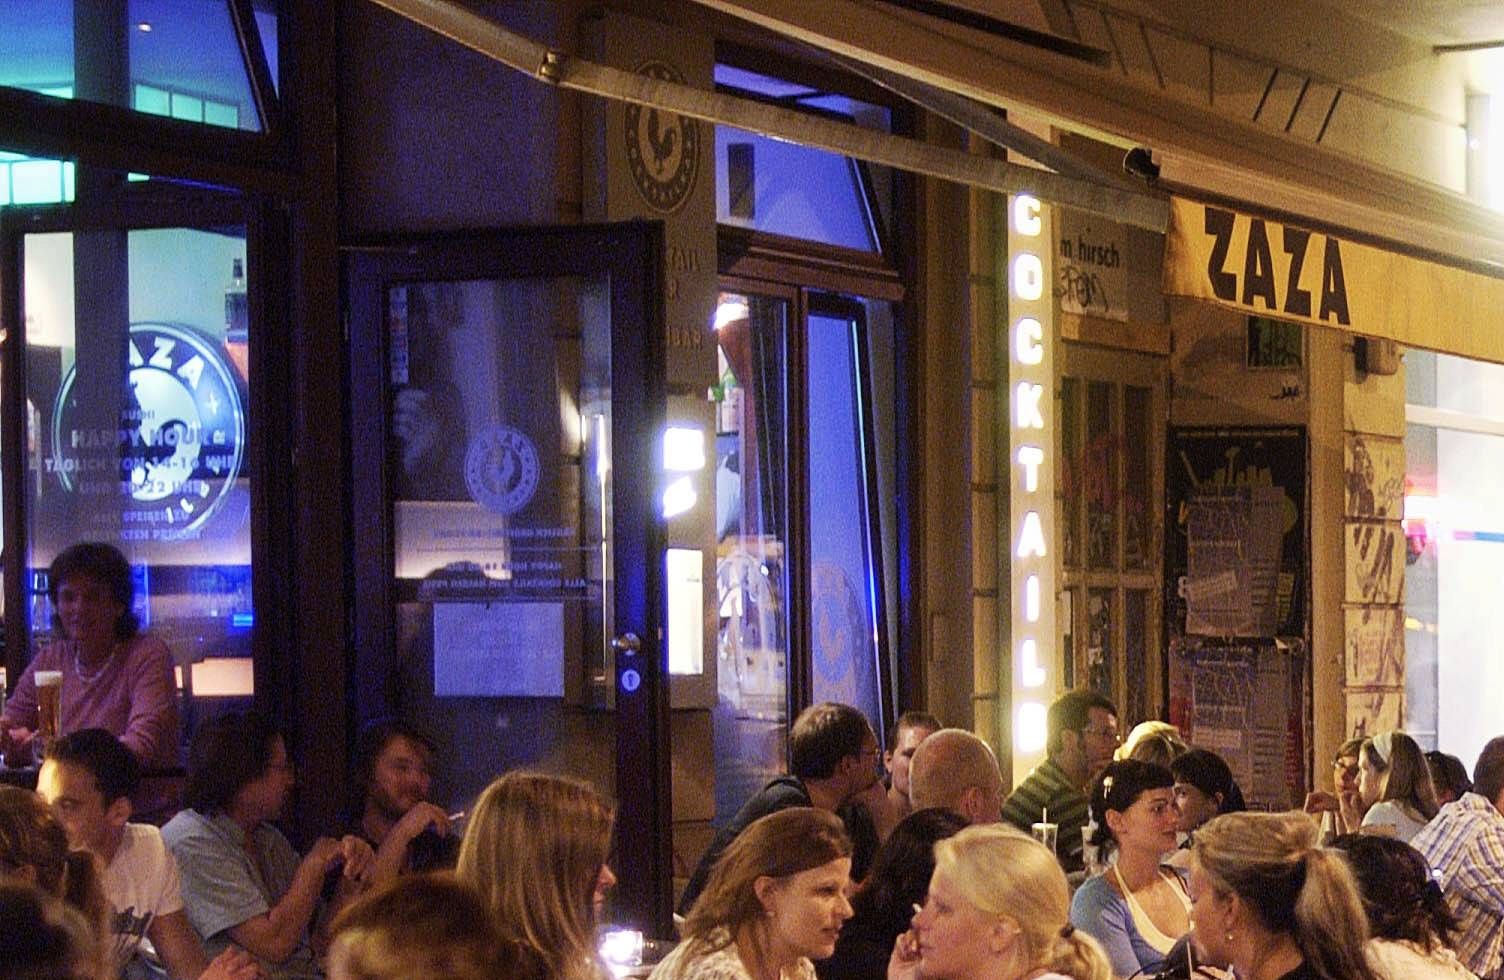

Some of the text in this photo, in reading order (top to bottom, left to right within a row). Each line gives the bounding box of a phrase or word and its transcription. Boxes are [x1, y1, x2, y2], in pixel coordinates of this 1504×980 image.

[1078, 235, 1120, 268] hirsch
[1204, 206, 1350, 325] ZAZA
[71, 427, 211, 448] HAPPY HOUR
[114, 456, 145, 470] VON
